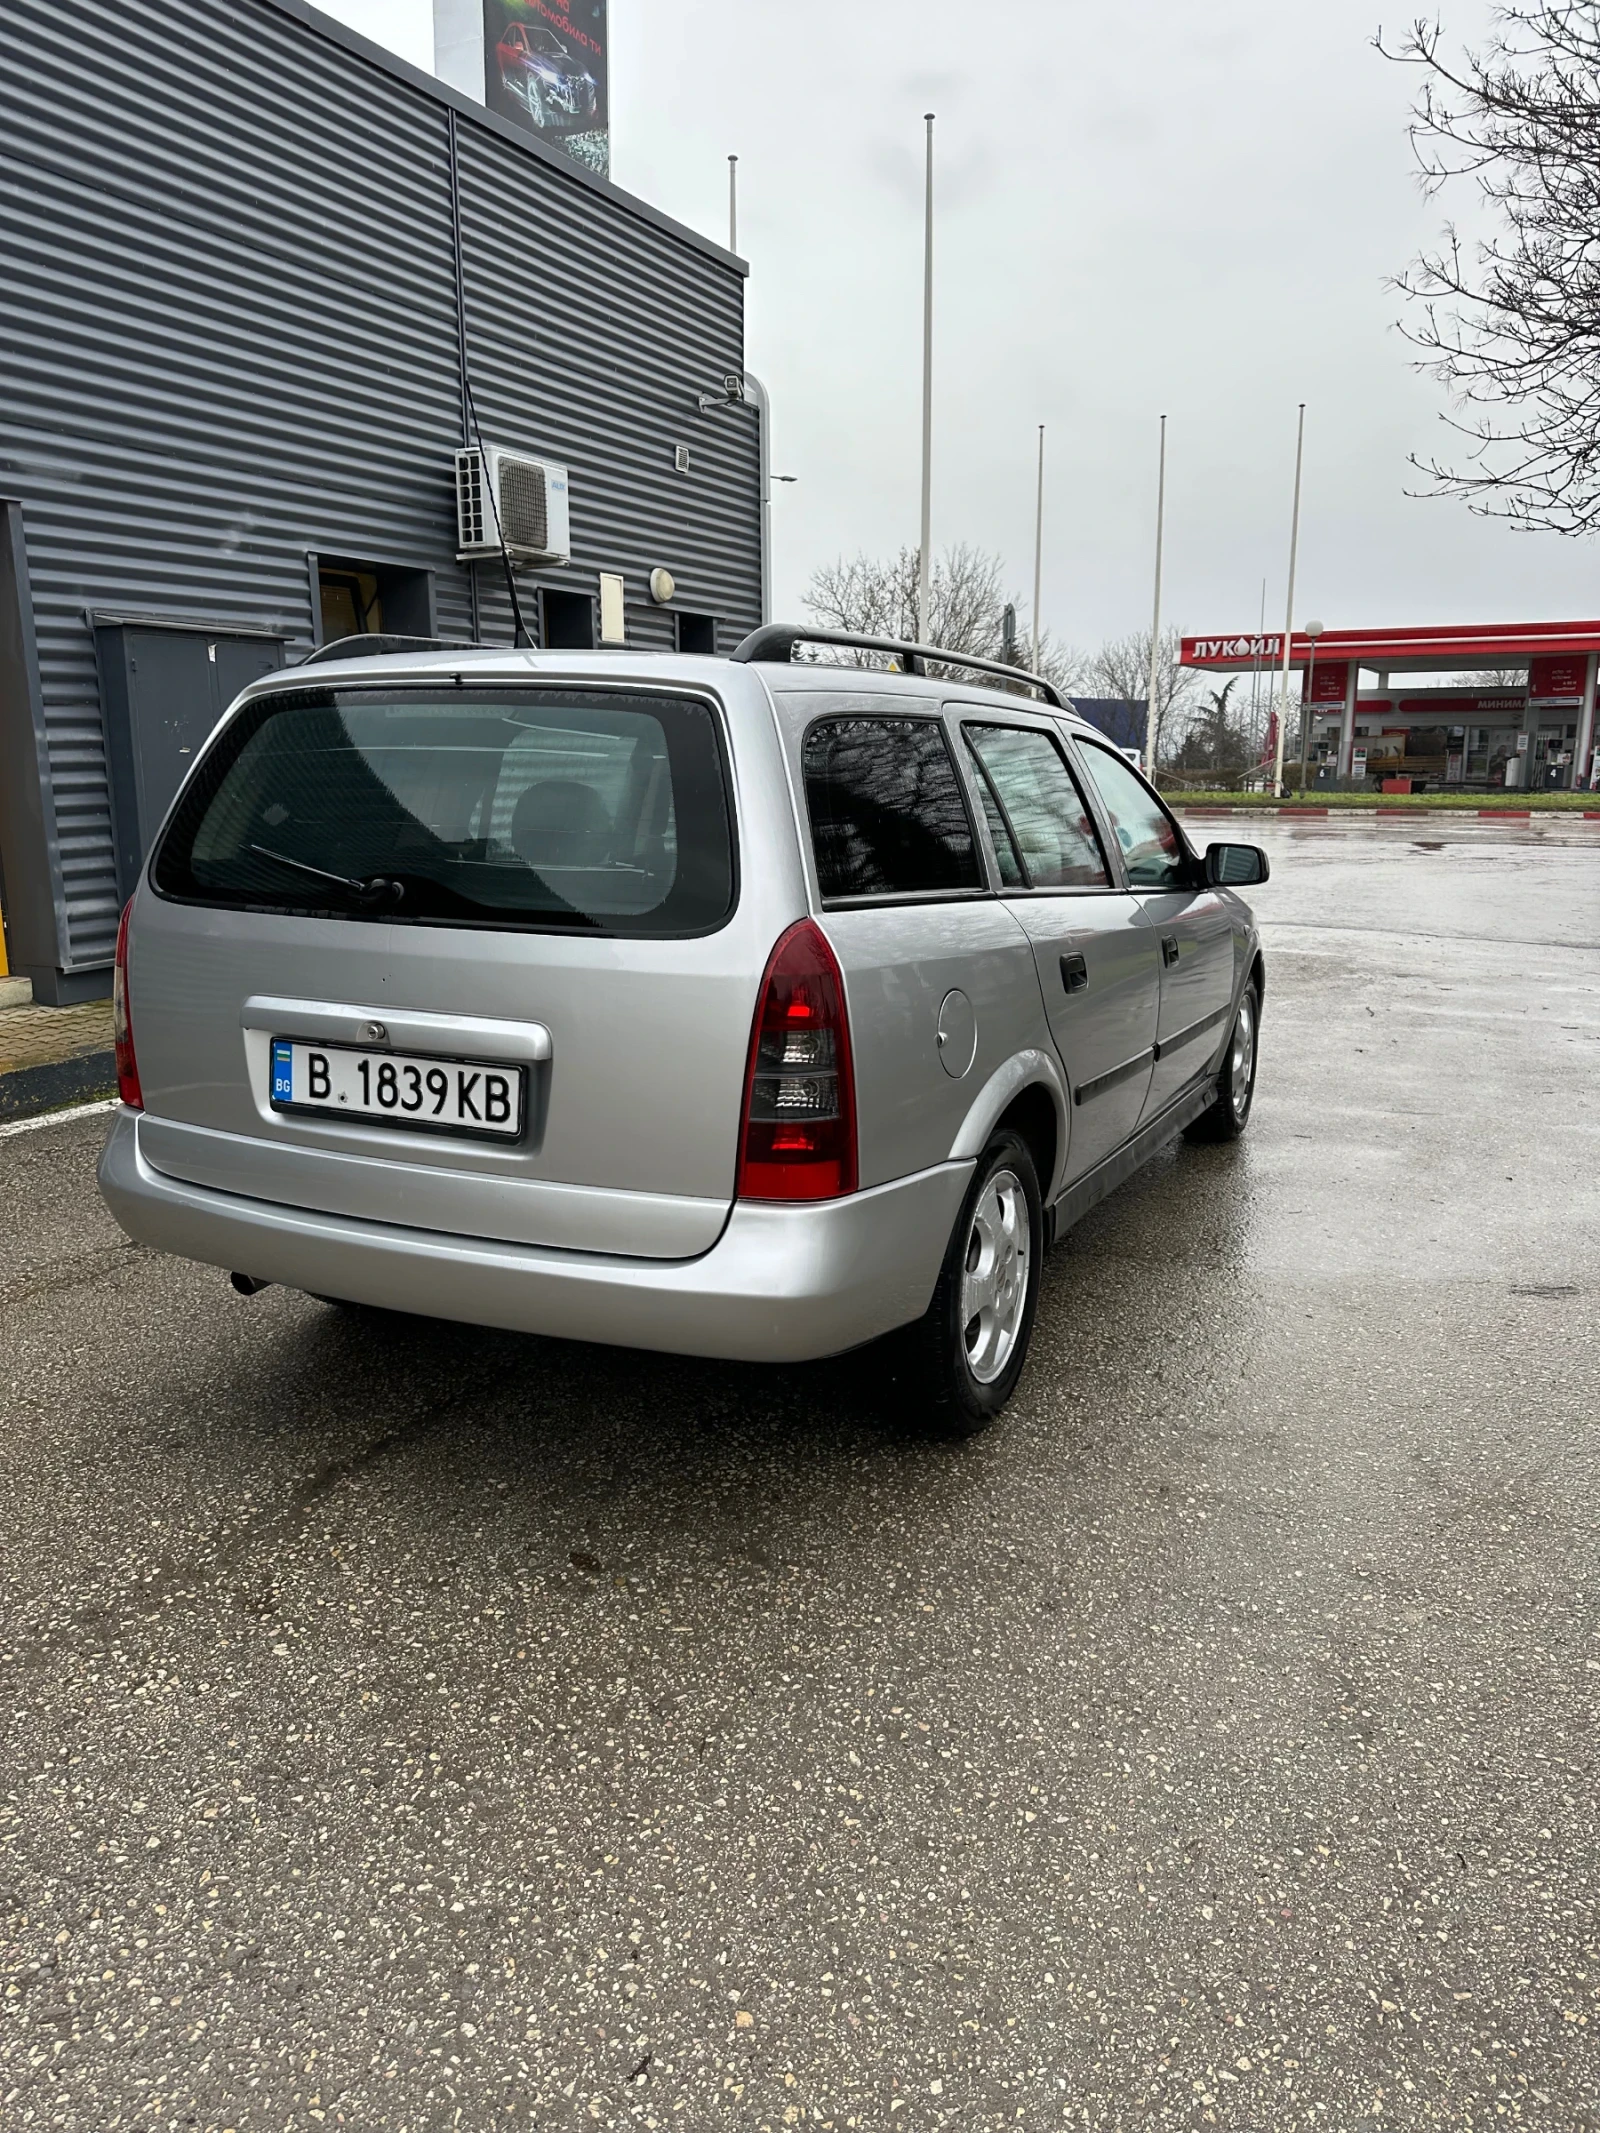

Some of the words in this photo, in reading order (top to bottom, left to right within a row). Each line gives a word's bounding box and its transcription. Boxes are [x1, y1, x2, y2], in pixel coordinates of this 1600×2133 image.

[1550, 769, 1556, 777] 4
[275, 1079, 291, 1093] BG
[308, 1053, 331, 1099] B
[357, 1059, 449, 1115] 1839
[458, 1071, 511, 1124] KB
